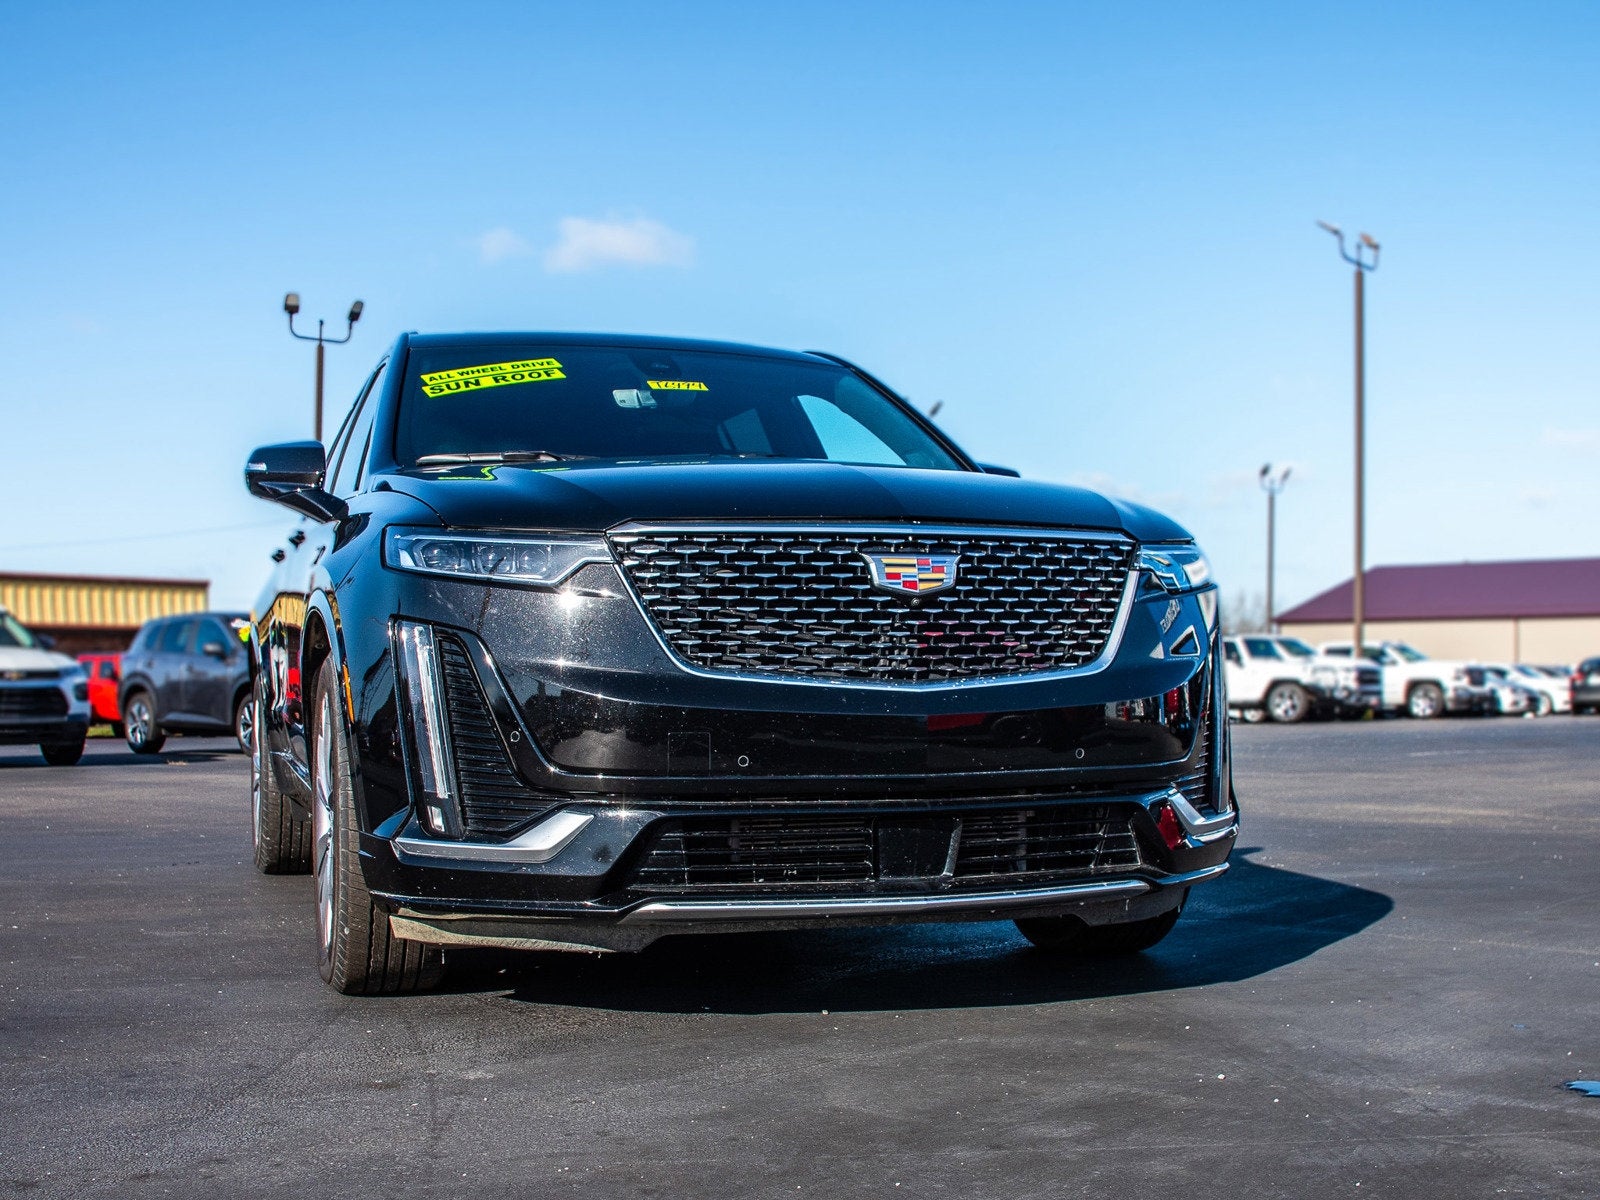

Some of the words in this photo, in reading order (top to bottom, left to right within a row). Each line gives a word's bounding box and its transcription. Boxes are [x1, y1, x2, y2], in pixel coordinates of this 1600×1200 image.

[429, 373, 455, 382] ALL
[457, 366, 508, 376] WHEEL
[511, 360, 555, 370] DRIVE
[429, 378, 481, 395] SUN
[491, 369, 556, 384] ROOF
